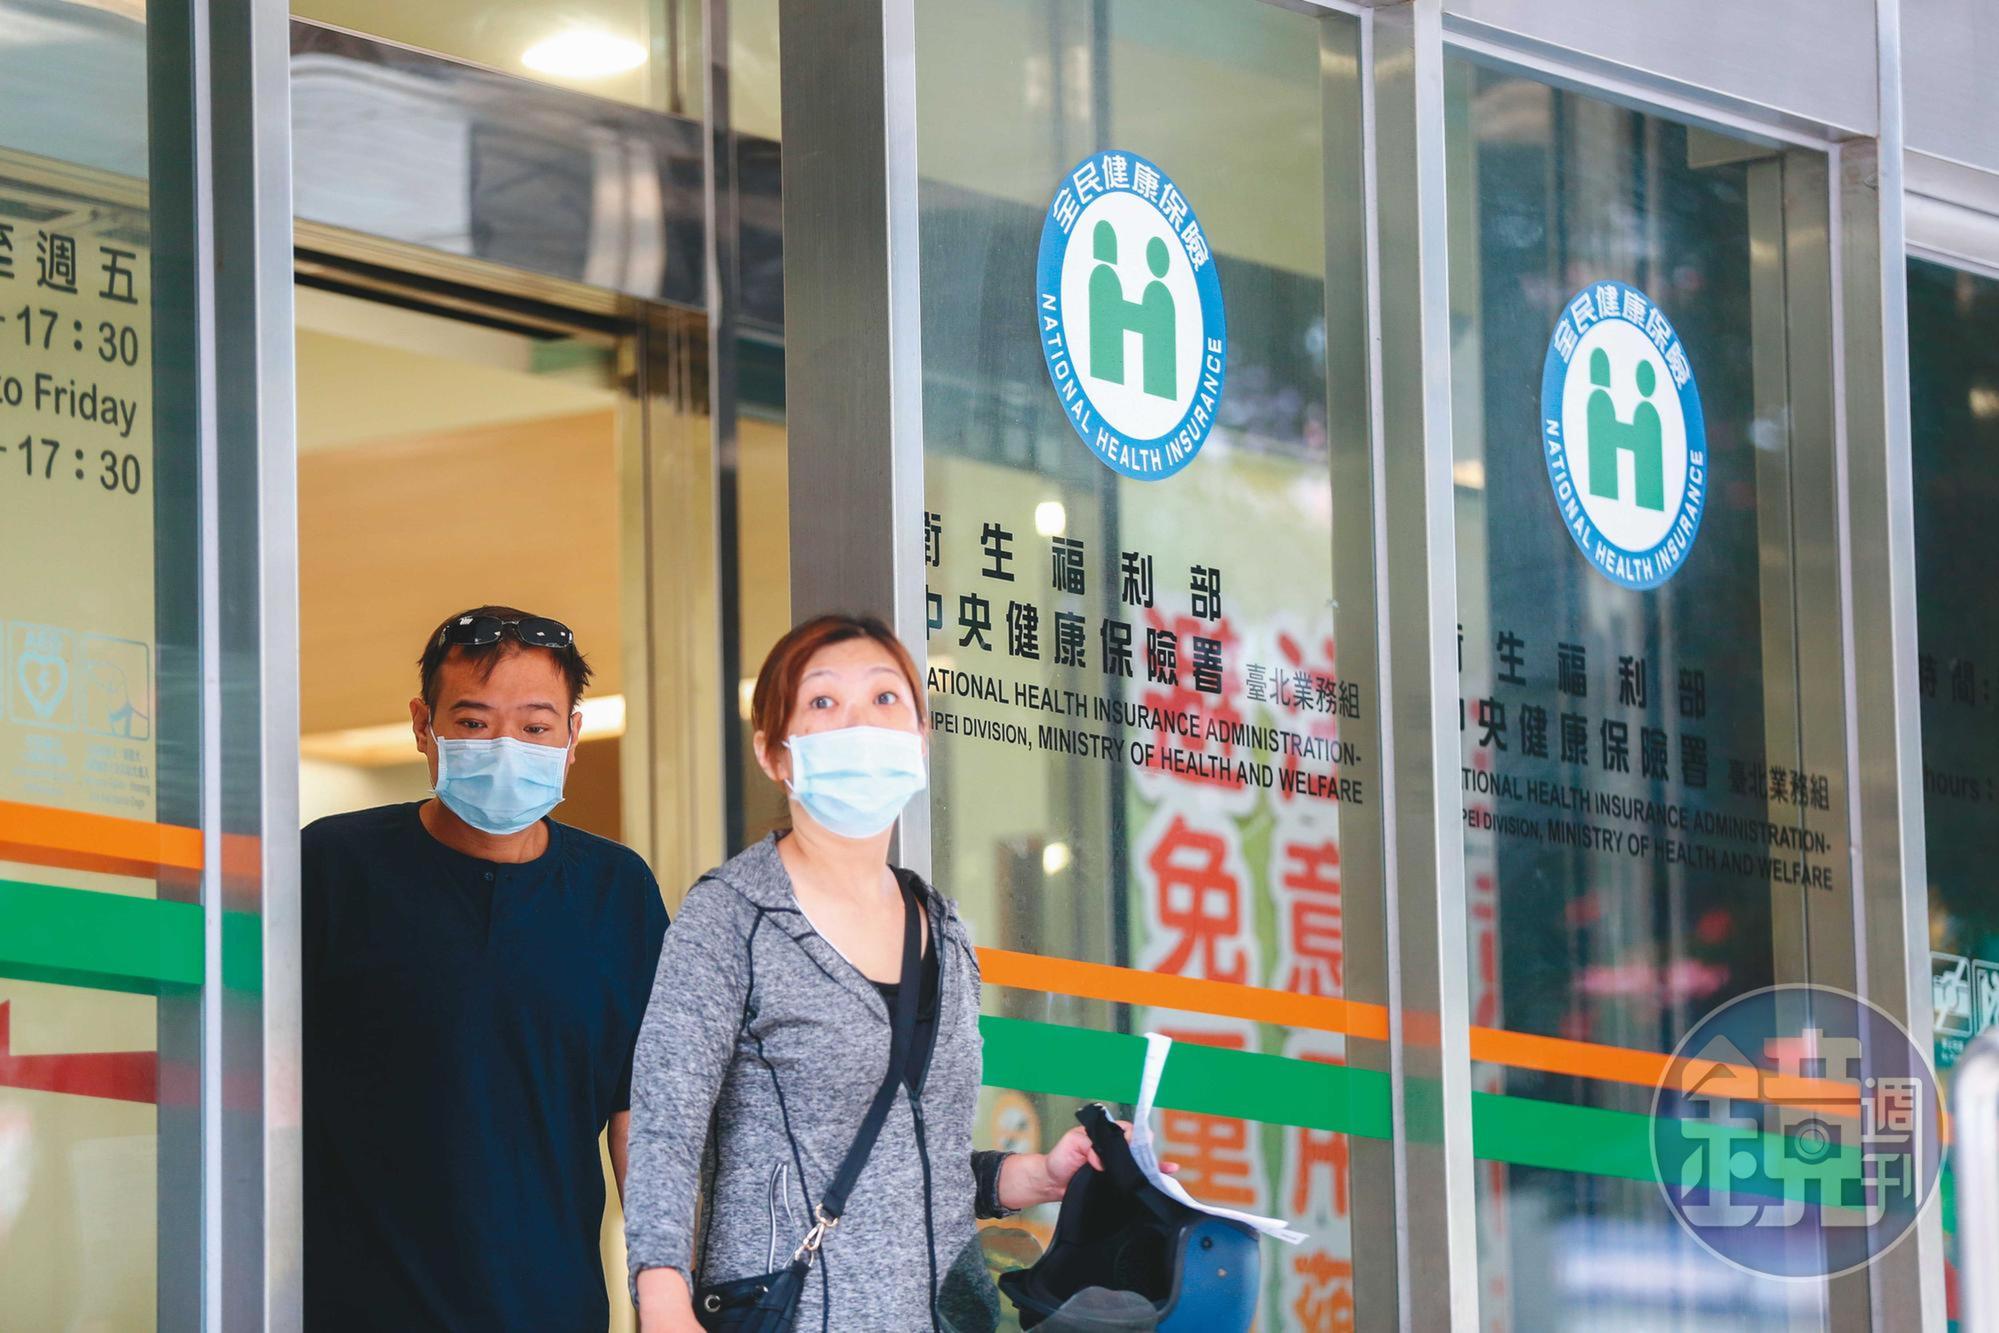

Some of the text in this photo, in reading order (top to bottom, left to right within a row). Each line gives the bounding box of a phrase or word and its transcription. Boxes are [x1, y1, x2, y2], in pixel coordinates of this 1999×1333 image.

[1053, 154, 1210, 271] 全民健康保險
[1042, 293, 1222, 471] NATIONAL HEALTH INSURANCE
[1553, 285, 1691, 390] 全民健康保險
[35, 372, 137, 438] Friday
[1546, 419, 1703, 581] NATIONAL HEALTH INSURANCE
[1246, 663, 1361, 719] 臺北業務組
[1458, 624, 1706, 720] 生福利部
[963, 716, 1032, 751] DIVISION,
[1039, 725, 1124, 762] MINISTRY
[1131, 741, 1154, 766] OF
[1161, 747, 1231, 781] HEALTH
[1236, 761, 1273, 788] AND
[1279, 767, 1363, 804] WELFARE
[1015, 682, 1087, 718] HEALTH
[1094, 696, 1200, 738] INSURANCE
[1206, 718, 1361, 767] ADMINISTRATION-
[1459, 696, 1708, 788] 央健康保險署
[1461, 767, 1522, 801] TIONAL
[1527, 778, 1590, 812] HEALTH
[1595, 792, 1689, 829] INSURANCE
[1483, 812, 1542, 841] DIVISION,
[1548, 818, 1622, 853] MINISTRY
[1628, 834, 1649, 858] OF
[1654, 838, 1716, 873] HEALTH
[1721, 850, 1753, 876] AND
[1758, 855, 1833, 891] WELFARE
